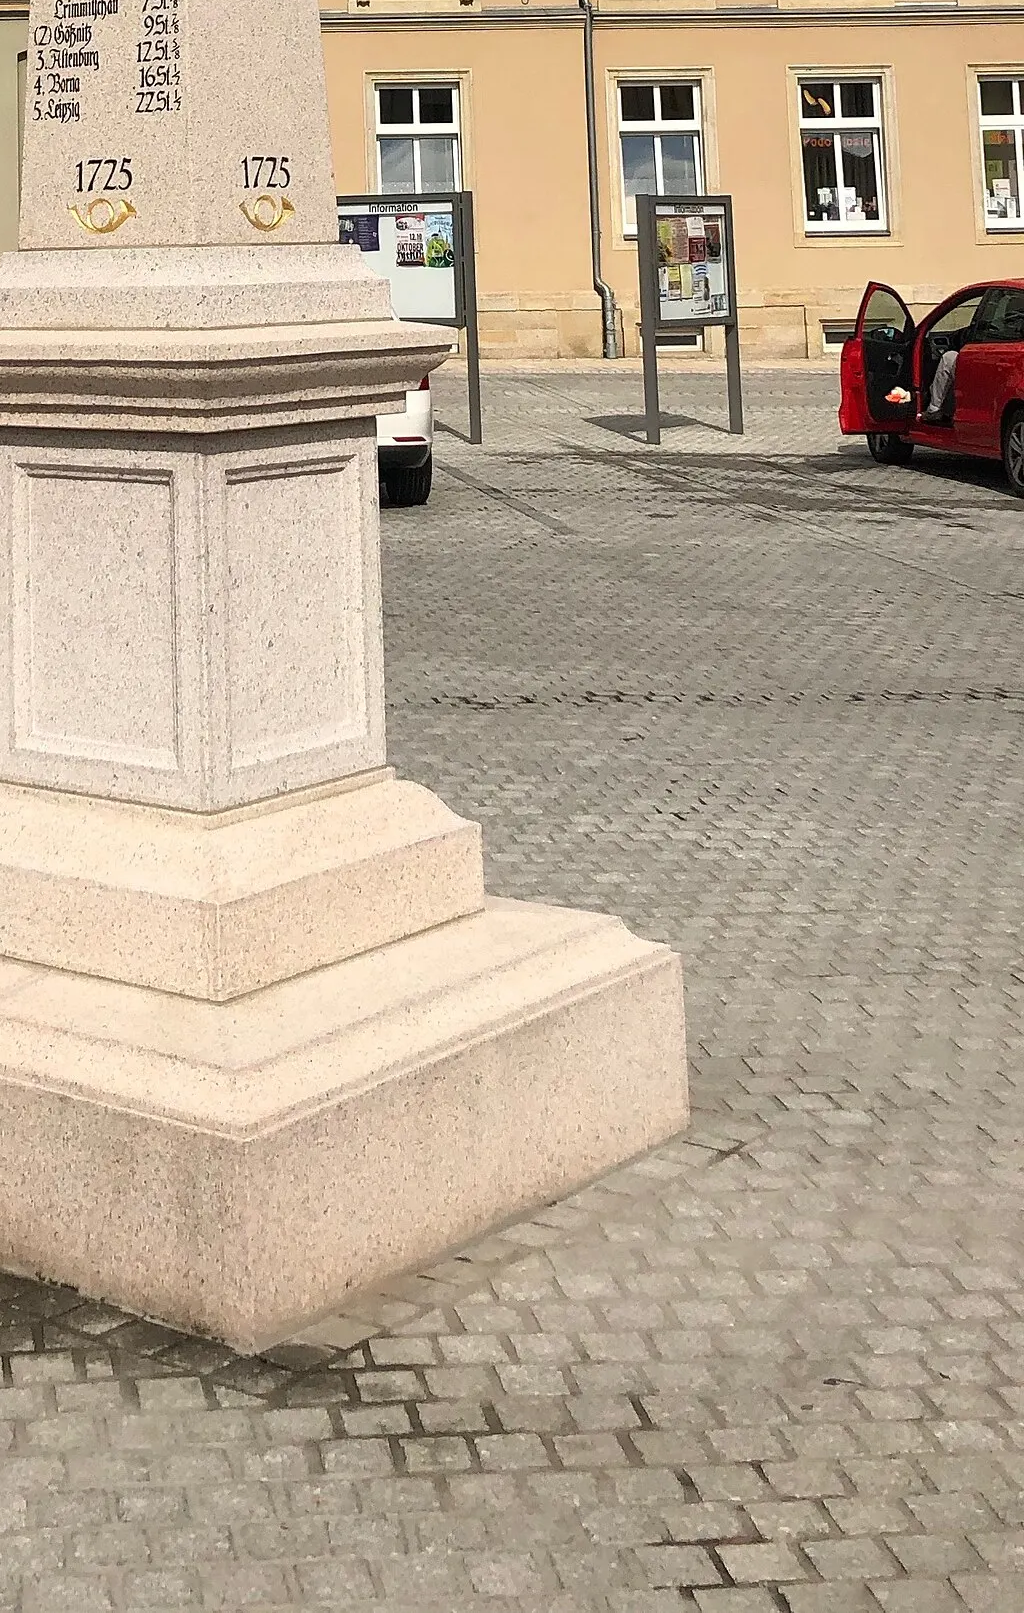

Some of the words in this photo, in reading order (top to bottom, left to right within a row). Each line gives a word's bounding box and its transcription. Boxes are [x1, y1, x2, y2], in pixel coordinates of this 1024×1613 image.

[34, 25, 52, 46] (2)
[48, 45, 99, 71] Altenburg
[34, 75, 45, 96] 4.
[47, 73, 80, 94] Borna
[44, 98, 80, 123] Leipzig
[76, 157, 133, 192] 1725
[240, 156, 291, 189] 1725
[369, 203, 419, 213] Information
